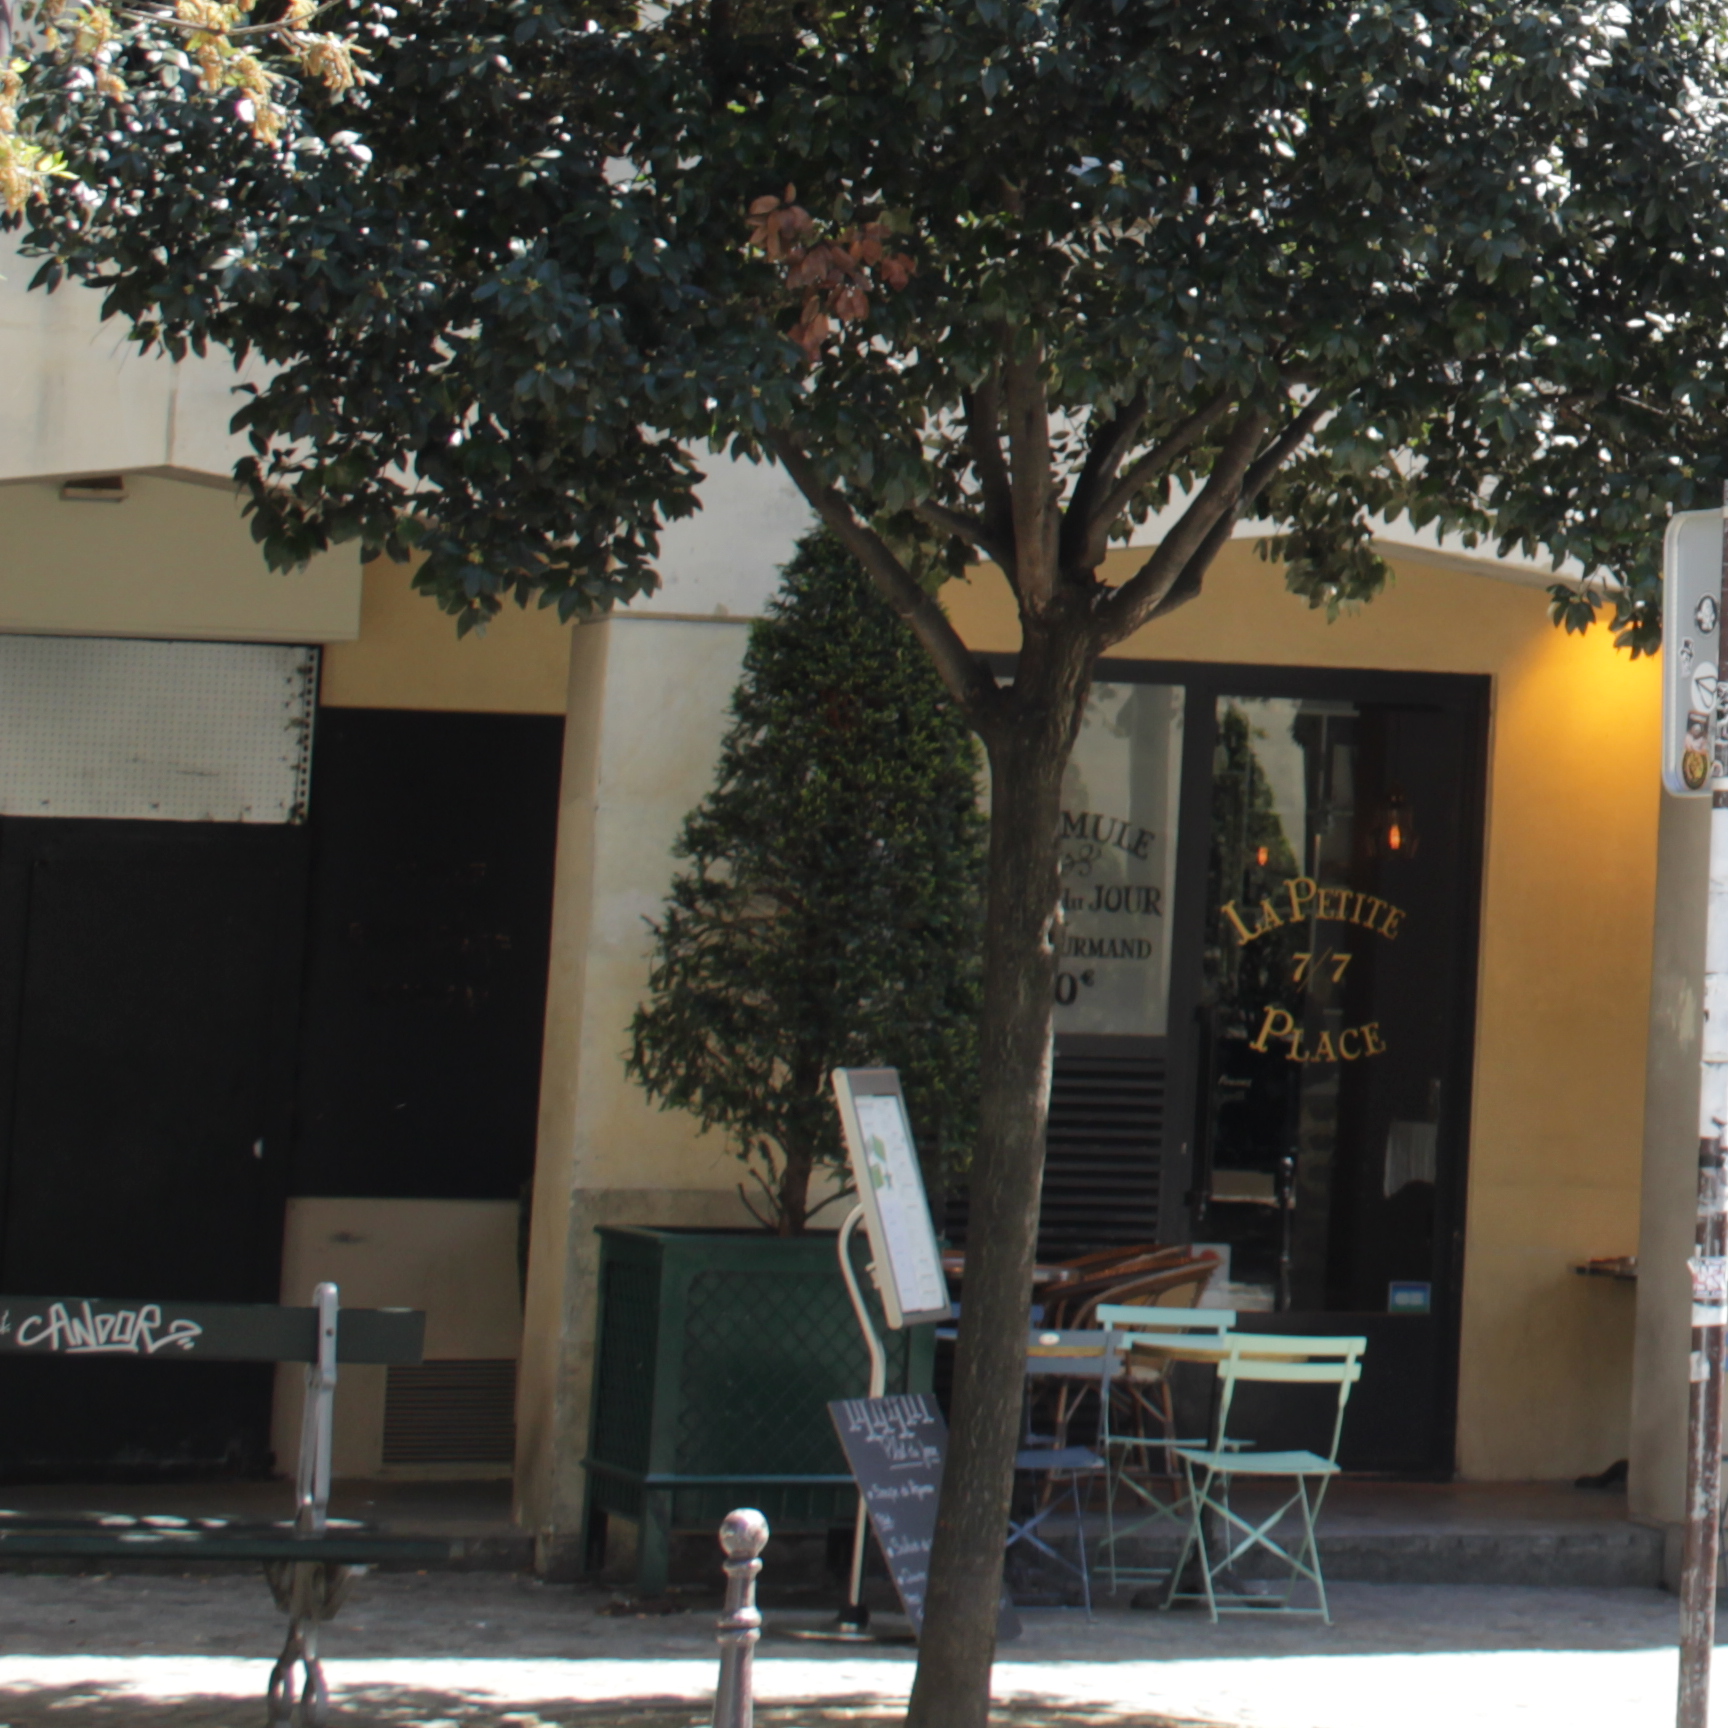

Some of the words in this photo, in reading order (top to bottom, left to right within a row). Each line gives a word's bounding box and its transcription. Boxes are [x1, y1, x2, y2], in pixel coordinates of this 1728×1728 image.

[1061, 810, 1155, 861] MULE
[1088, 884, 1163, 918] JOUR
[1062, 933, 1153, 960] URMAND
[1054, 968, 1096, 1007] 0€
[1292, 946, 1353, 994] 7/7
[1249, 1004, 1387, 1063] PLACE
